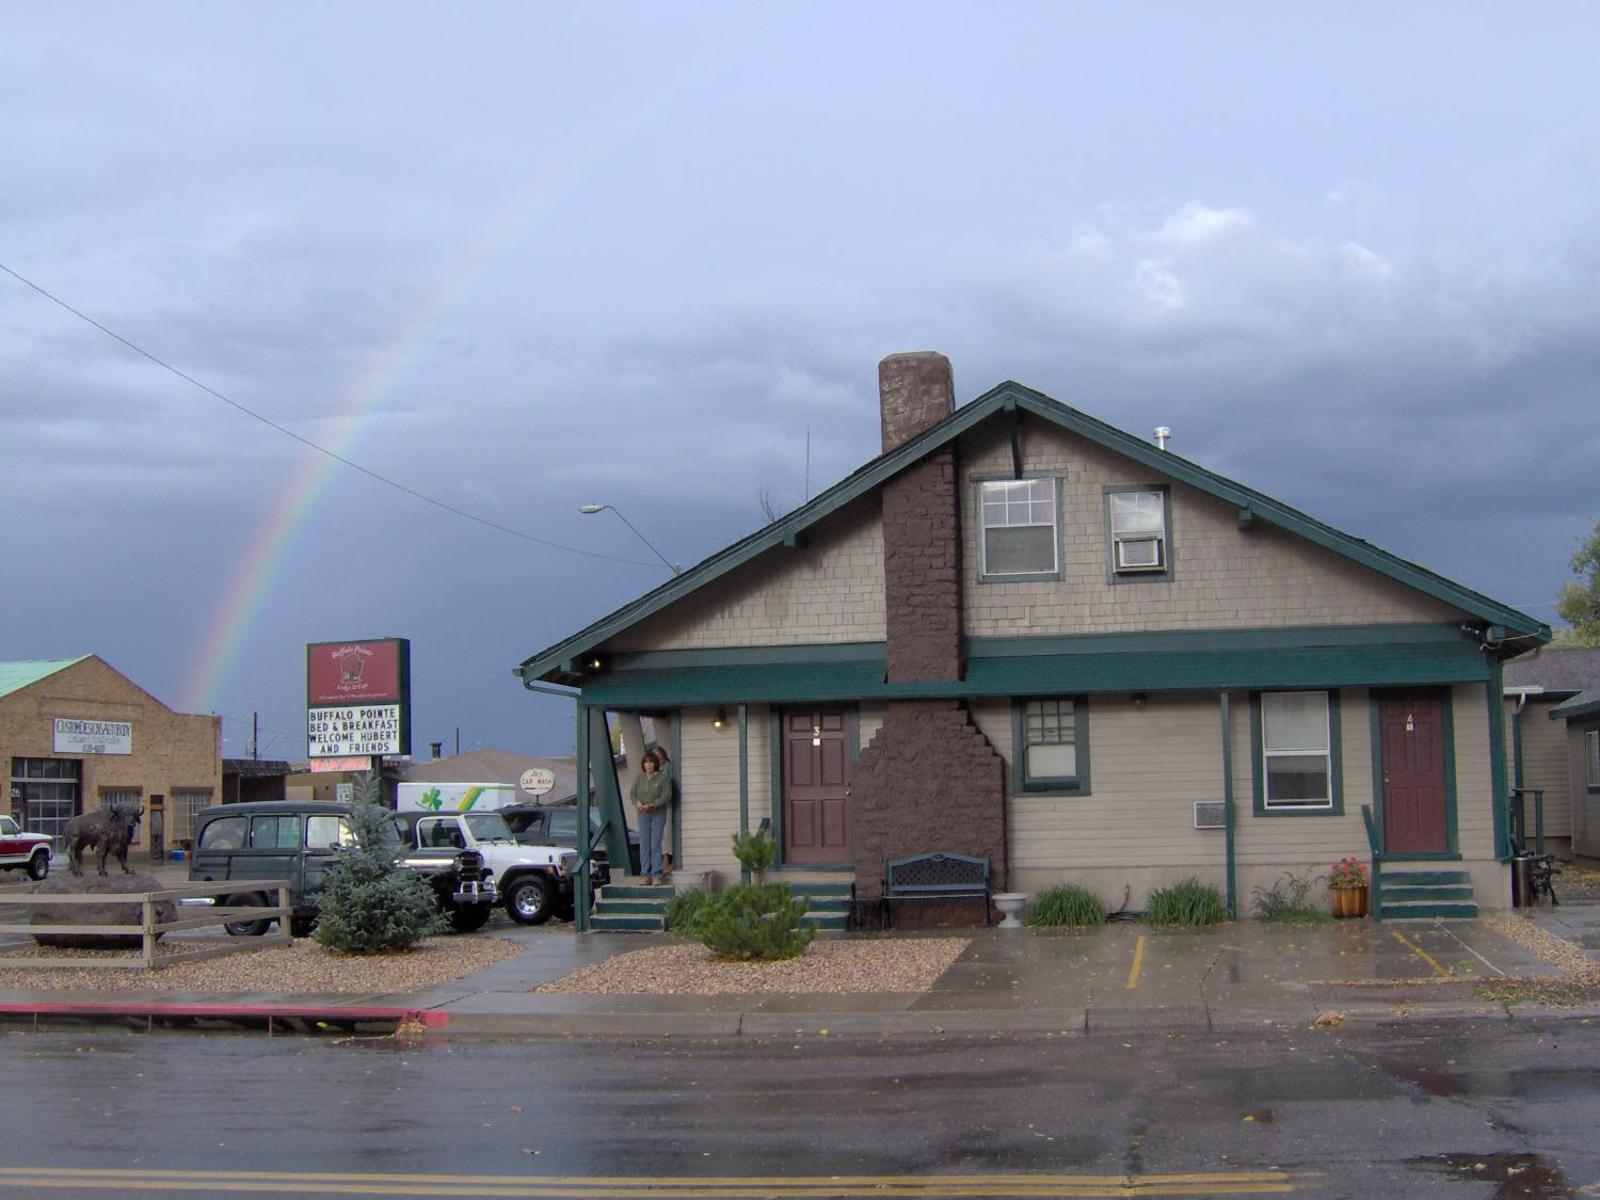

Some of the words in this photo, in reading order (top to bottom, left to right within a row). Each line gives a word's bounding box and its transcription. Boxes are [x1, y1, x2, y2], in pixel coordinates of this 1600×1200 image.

[310, 711, 353, 721] BUFFALO
[360, 708, 395, 719] POINTE
[310, 722, 328, 732] BED
[332, 722, 338, 732] &
[342, 720, 398, 731] BREAKFAST
[813, 726, 819, 736] 3
[310, 732, 354, 743] WELCOME
[361, 730, 397, 742] HUBERT
[320, 744, 339, 754] AND
[350, 742, 390, 752] FRIENDS
